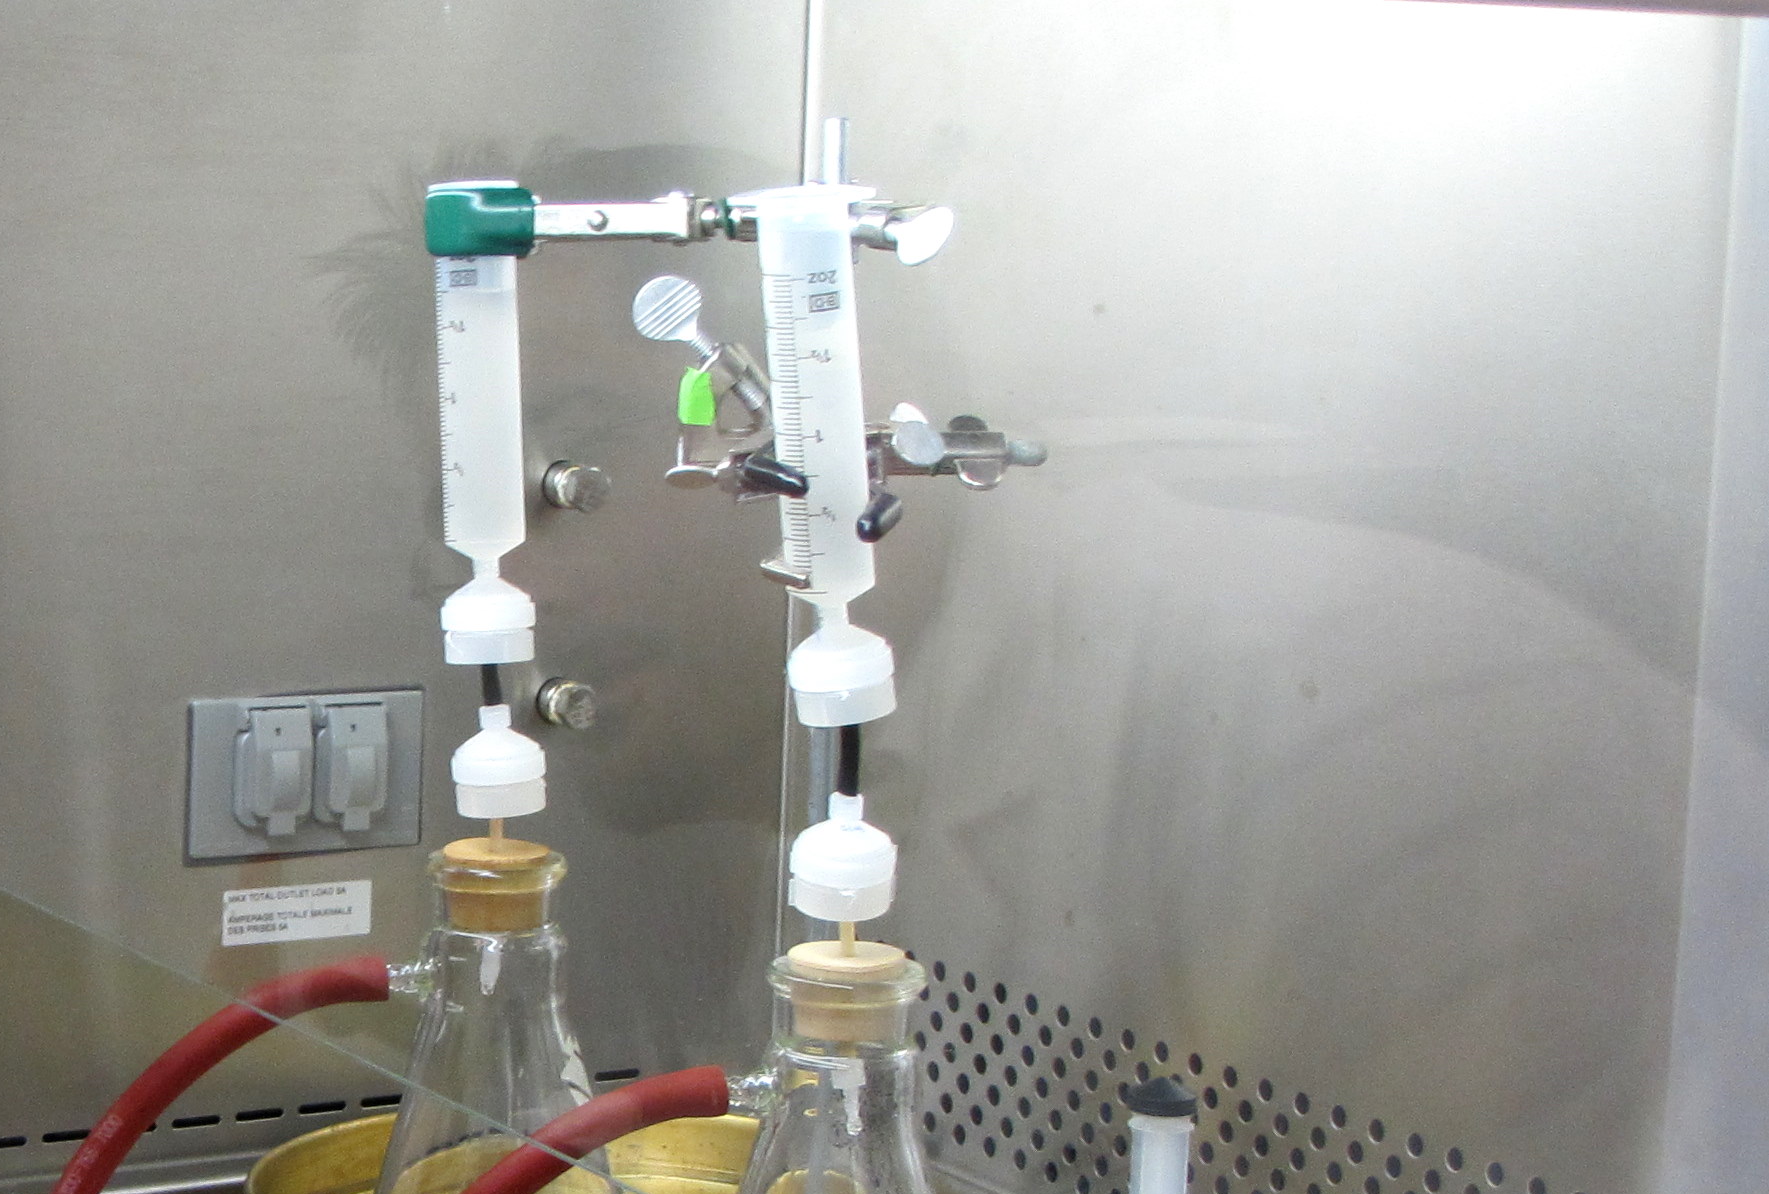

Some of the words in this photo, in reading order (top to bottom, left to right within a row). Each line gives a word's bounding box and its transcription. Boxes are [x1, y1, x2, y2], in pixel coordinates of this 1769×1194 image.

[250, 892, 274, 901] TOTAL
[276, 888, 309, 899] OUTLET
[312, 887, 334, 897] LOAD
[228, 912, 274, 923] AMPERAGE
[277, 910, 309, 920] TOTALE
[311, 906, 352, 917] MAXIMALE
